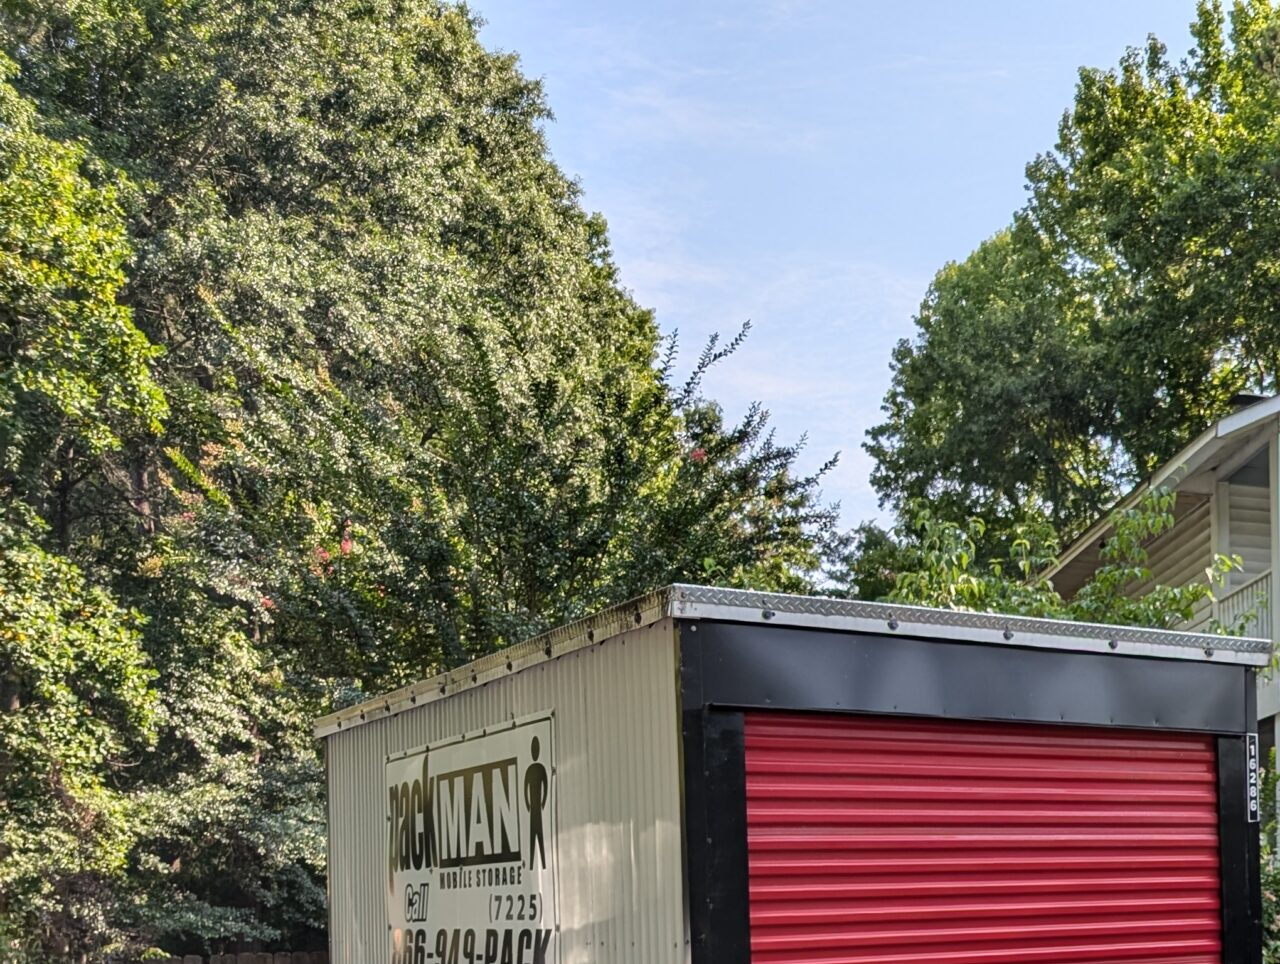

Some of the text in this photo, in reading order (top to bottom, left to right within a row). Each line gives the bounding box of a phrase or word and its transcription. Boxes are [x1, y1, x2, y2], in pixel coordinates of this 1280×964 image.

[1248, 744, 1258, 812] 16286
[439, 865, 522, 890] MOBILE STORAGE
[405, 883, 430, 922] Call
[488, 892, 543, 924] (7225)
